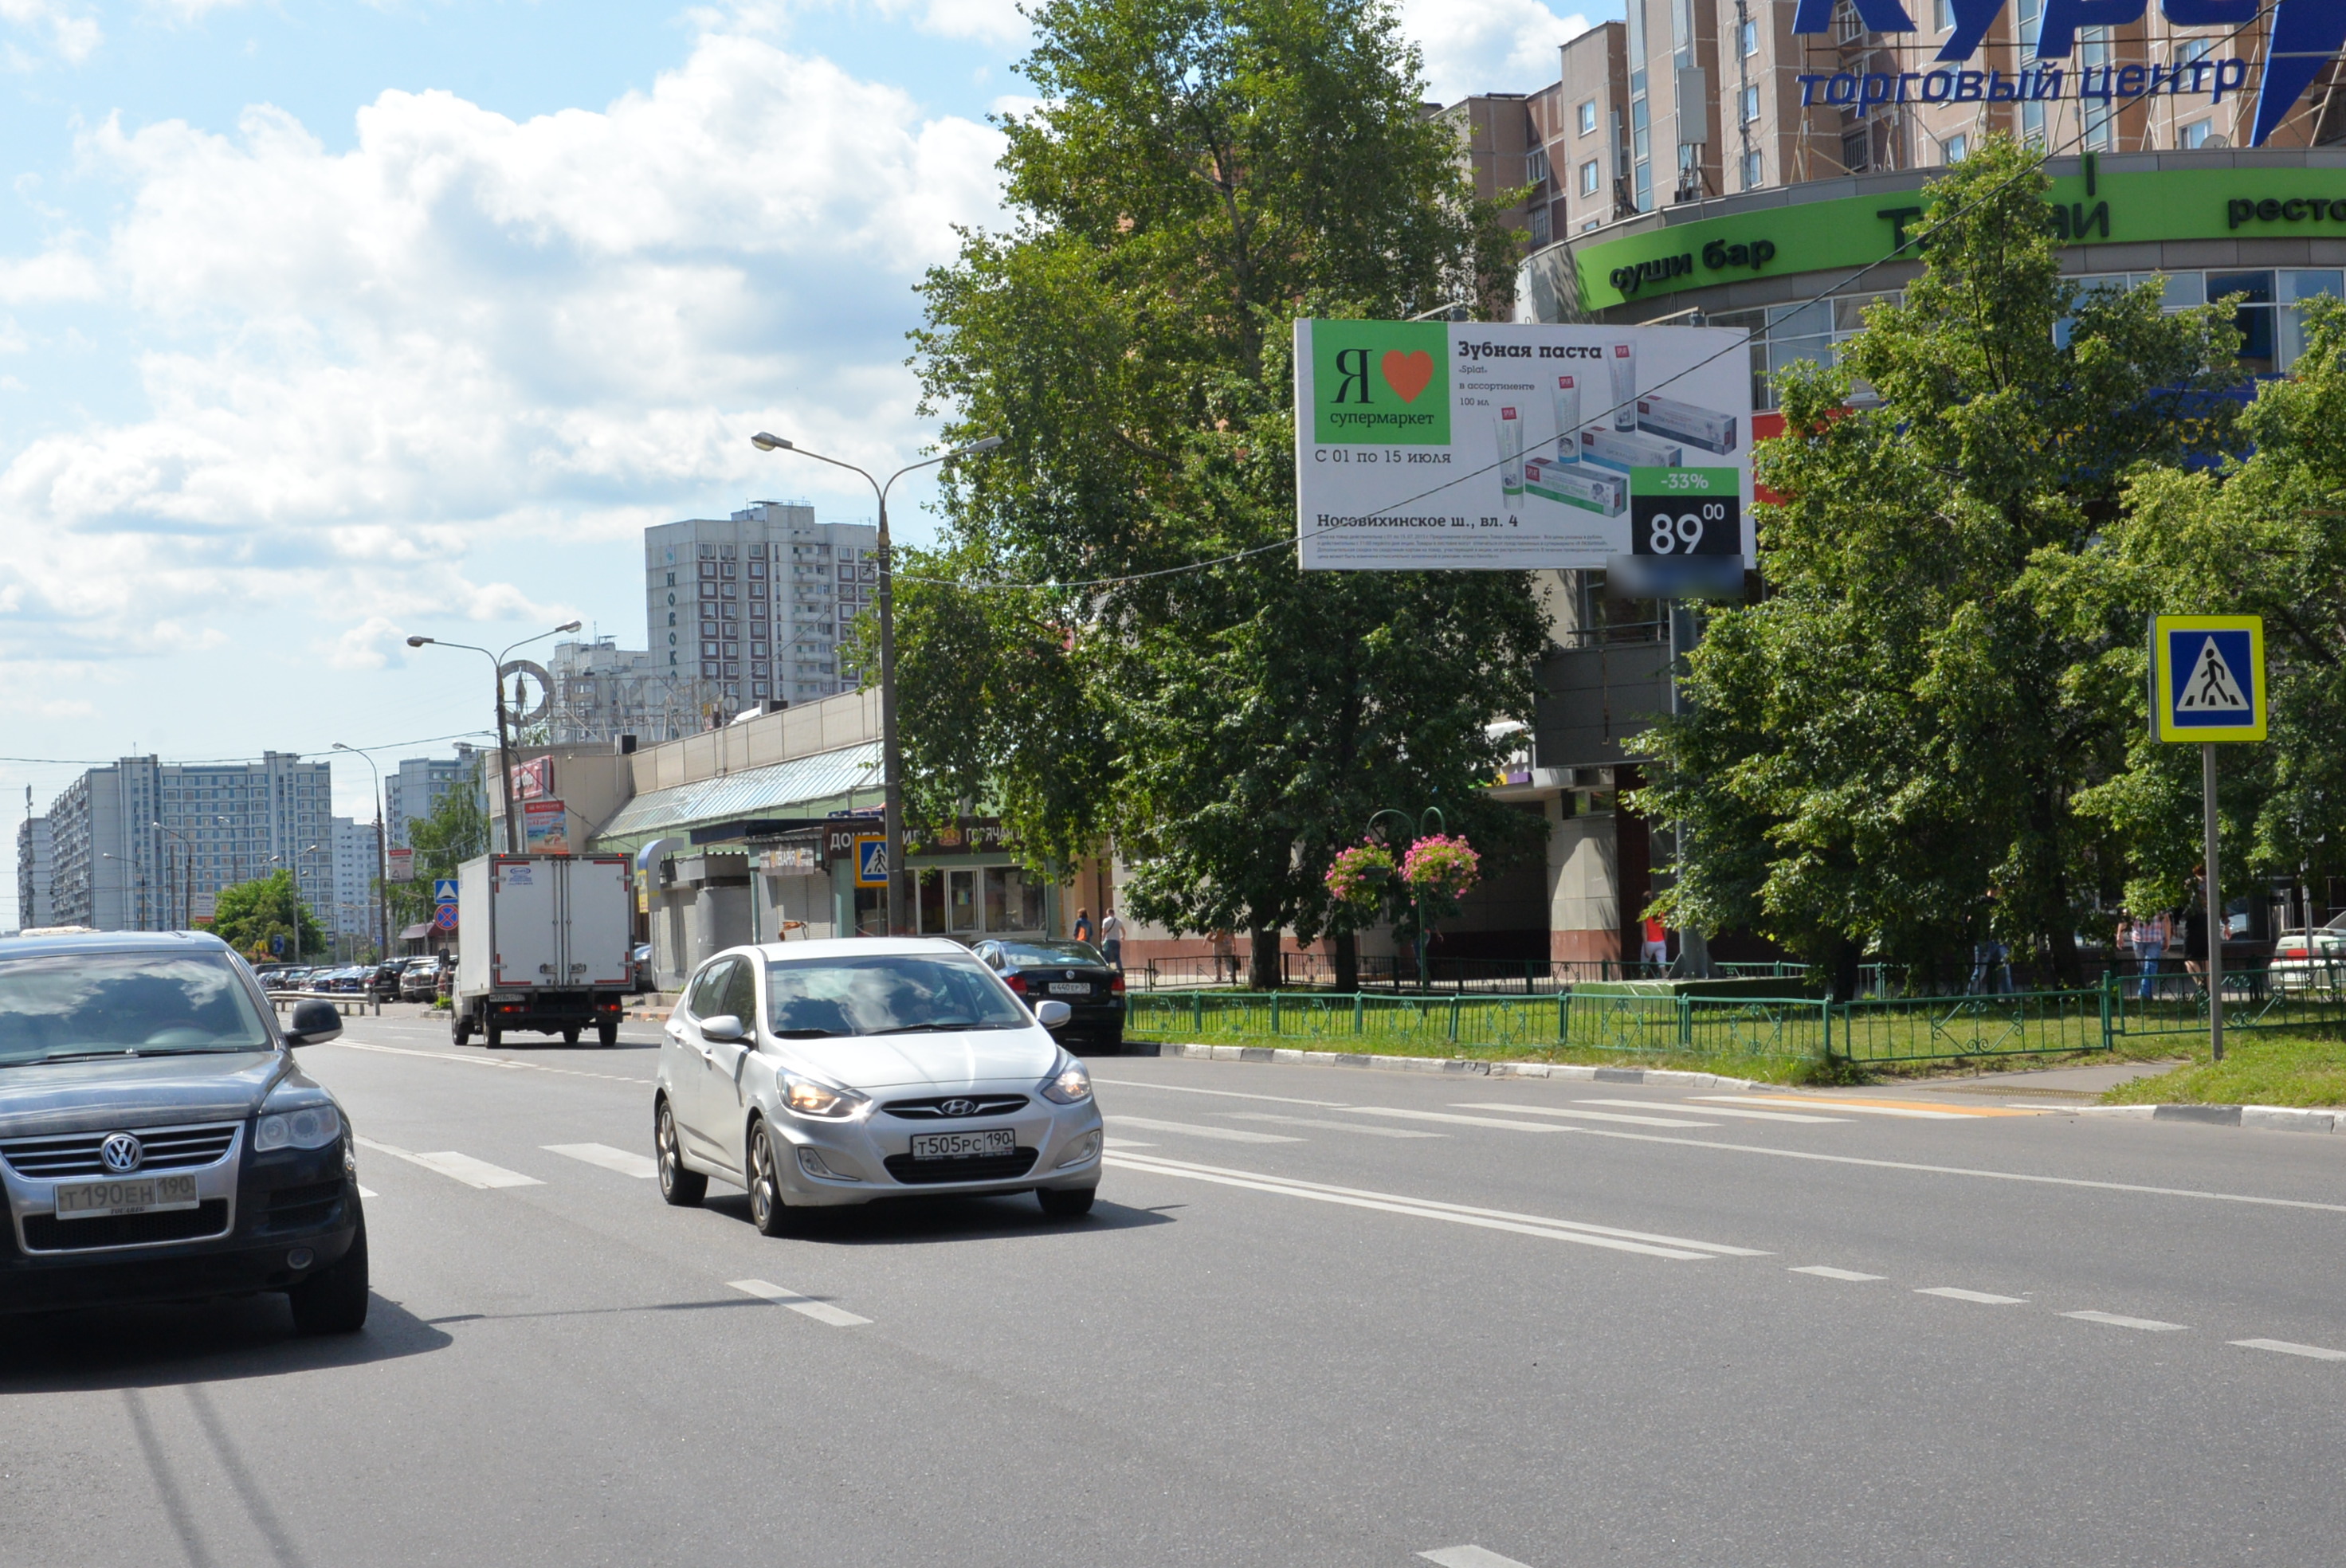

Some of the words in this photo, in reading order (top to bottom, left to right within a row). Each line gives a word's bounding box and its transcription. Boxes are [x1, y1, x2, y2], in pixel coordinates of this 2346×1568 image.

[1796, 60, 2063, 118] торговый
[2081, 57, 2247, 105] центр
[1609, 253, 1693, 294] суши
[1702, 239, 1775, 270] бар
[1458, 340, 1532, 362] Зубная
[1539, 344, 1603, 359] паста
[1330, 348, 1374, 404] Я
[1467, 382, 1536, 393] ассортименте
[1460, 397, 1475, 406] 100
[1329, 411, 1435, 429] супермаркет
[1315, 450, 1327, 464] С
[1332, 450, 1350, 464] 01
[1357, 453, 1378, 465] по
[1384, 450, 1401, 464] 15
[1407, 453, 1452, 465] июля
[1660, 474, 1708, 490] -33%
[1316, 514, 1446, 529] Носовихинское
[1451, 516, 1475, 531] ш.,
[1481, 516, 1504, 529] вл.
[1508, 515, 1518, 527] 4
[1650, 514, 1704, 555] 89
[1703, 503, 1724, 520] 00
[987, 1132, 1010, 1146] 190
[158, 1176, 190, 1195] 190
